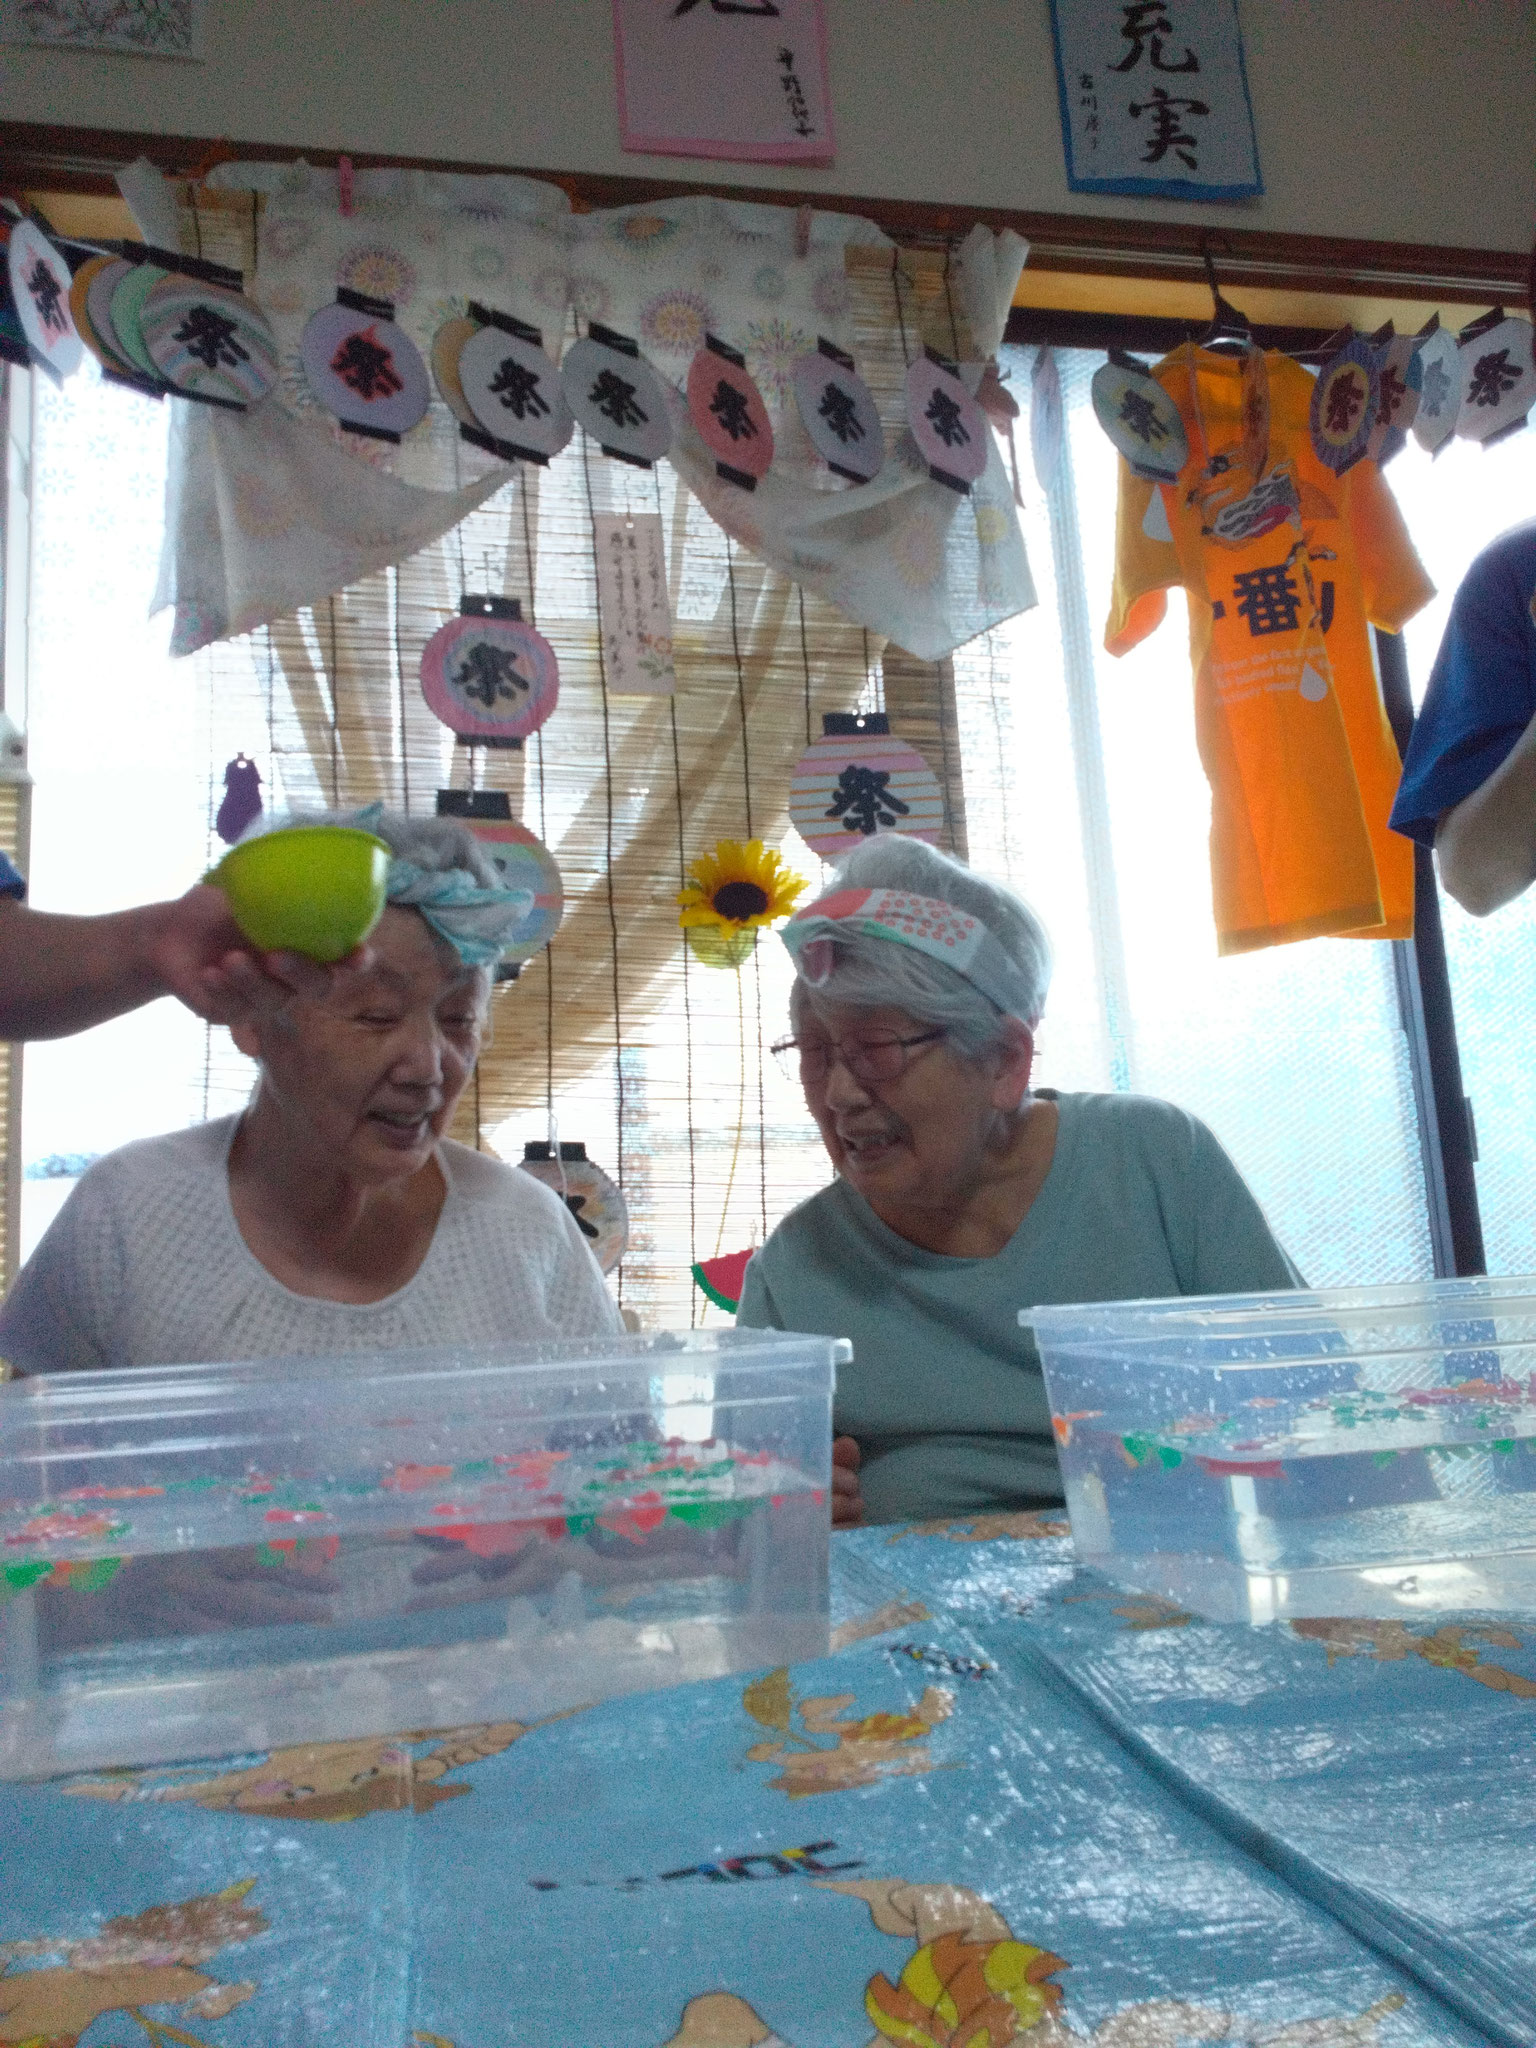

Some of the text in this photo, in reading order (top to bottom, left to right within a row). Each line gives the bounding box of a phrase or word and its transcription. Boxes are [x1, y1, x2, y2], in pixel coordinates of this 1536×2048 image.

[1105, 0, 1211, 170] 充実
[28, 258, 68, 333] 祭
[173, 304, 250, 368] 祭
[332, 332, 402, 399] 祭
[488, 357, 551, 420] 祭
[588, 368, 649, 428] 祭
[1325, 371, 1365, 433] 祭
[1423, 356, 1452, 417] 祭
[1466, 348, 1523, 407] 祭
[709, 379, 759, 441] 祭
[817, 381, 866, 444] 祭
[925, 387, 972, 448] 祭
[1119, 389, 1169, 442] 祭
[453, 641, 530, 705] 祭
[825, 764, 910, 834] 祭
